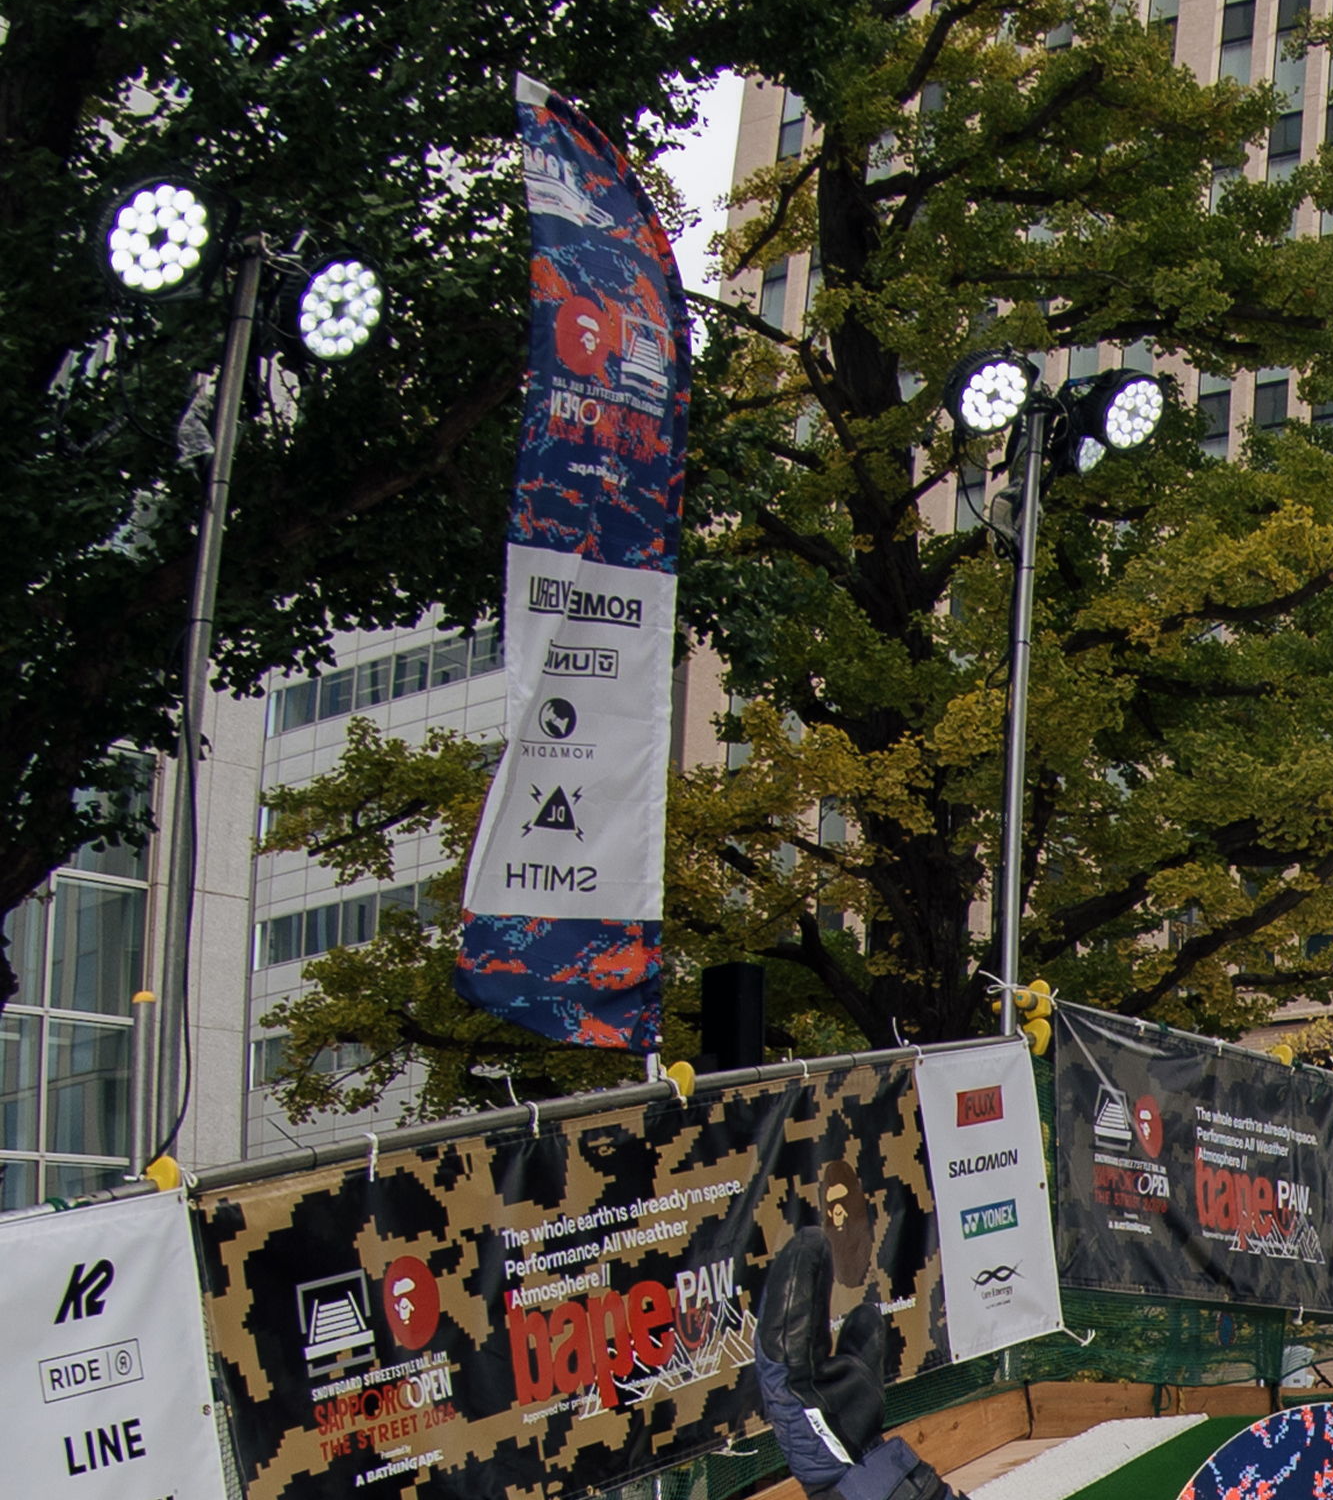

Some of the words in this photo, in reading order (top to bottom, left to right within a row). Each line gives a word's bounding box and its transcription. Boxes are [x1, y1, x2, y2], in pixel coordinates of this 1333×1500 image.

[964, 1092, 996, 1120] FLUX
[948, 1149, 1018, 1178] SALOMON
[1137, 1173, 1170, 1198] OPEN
[501, 1228, 530, 1250] The
[531, 1215, 576, 1242] whole
[981, 1205, 1015, 1229] YONEX
[504, 1241, 600, 1280] Performance
[601, 1233, 623, 1255] All
[624, 1219, 689, 1247] Weather
[54, 1259, 115, 1325] K2
[511, 1271, 600, 1310] Atmosphere
[676, 1258, 743, 1314] PAW.
[49, 1359, 102, 1391] RIDE
[311, 1376, 363, 1402] SNOWBOARD
[313, 1380, 416, 1437] SAPPORO
[406, 1366, 452, 1409] OPEN
[64, 1418, 146, 1476] LINE
[320, 1432, 352, 1462] THE
[356, 1414, 419, 1450] STREET
[355, 1473, 366, 1488] A
[366, 1456, 418, 1484] BATHING
